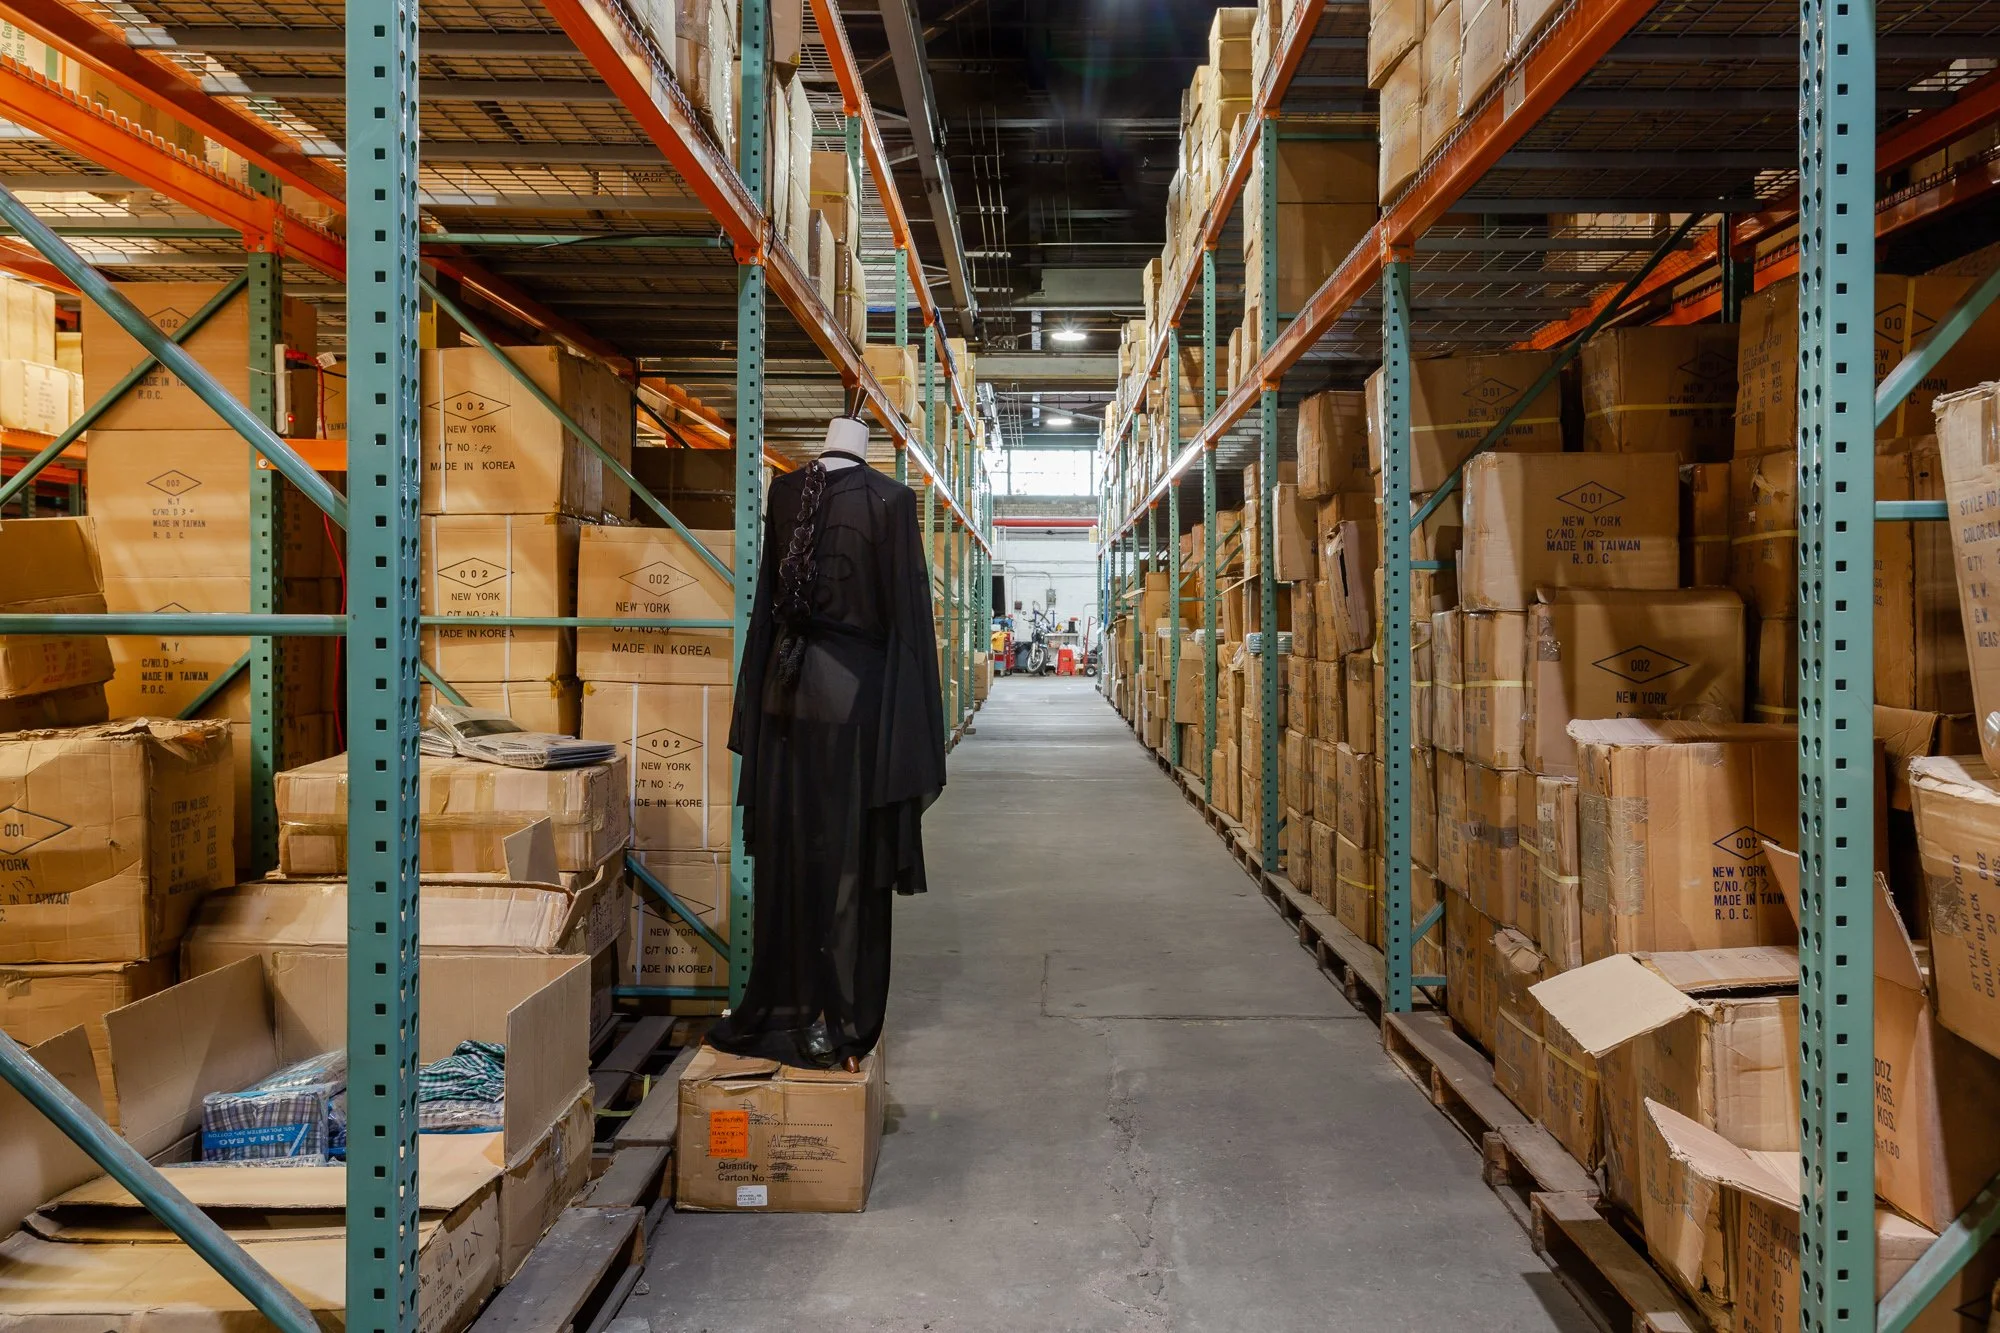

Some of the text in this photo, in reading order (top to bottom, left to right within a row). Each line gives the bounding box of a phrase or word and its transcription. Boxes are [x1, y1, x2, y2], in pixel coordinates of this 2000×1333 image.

[160, 318, 179, 328] 002
[1883, 316, 1903, 330] 00
[1874, 349, 1889, 360] EW
[447, 424, 497, 434] NEW YORK
[464, 462, 473, 471] IN
[482, 461, 516, 470] KOREA
[1580, 492, 1603, 504] 001
[1960, 495, 1984, 516] STYLE
[152, 519, 206, 528] MADE IN TAIWAN
[1562, 516, 1622, 526] NEW YORK
[1546, 540, 1641, 551] MADE IN TAIWAN
[649, 574, 670, 584] 002
[451, 592, 500, 601] NEW YORK
[615, 601, 671, 613] NEW YORK
[467, 628, 477, 638] IN
[480, 628, 515, 638] KOREA
[612, 643, 711, 656] MADE IN KOREA
[1631, 659, 1650, 672] 002
[141, 671, 209, 681] MADE IN TAIWAN
[1616, 690, 1668, 704] NEW YORK
[641, 762, 691, 771] NEW YORK
[657, 799, 667, 808] IN
[675, 799, 703, 808] KORE
[4, 823, 24, 837] 001
[1736, 836, 1758, 849] 002
[1712, 865, 1767, 877] NEW YORK
[9, 892, 71, 905] IN TAIWAN
[1714, 892, 1785, 906] MADE IN TAIW
[1986, 913, 1998, 935] 20
[650, 928, 670, 937] NEW
[645, 946, 660, 955] C/T
[665, 964, 675, 974] IN
[678, 964, 713, 974] KOREA
[1967, 940, 1982, 993] STYLE
[1874, 1057, 1892, 1083] DOZ
[1875, 1080, 1895, 1107] KGS.
[1877, 1104, 1896, 1132] KGS.
[218, 1137, 244, 1146] BAG
[718, 1160, 758, 1172] Quantity
[717, 1173, 765, 1182] Carton No
[1749, 1200, 1769, 1232] STYLE
[1773, 1268, 1782, 1289] 10
